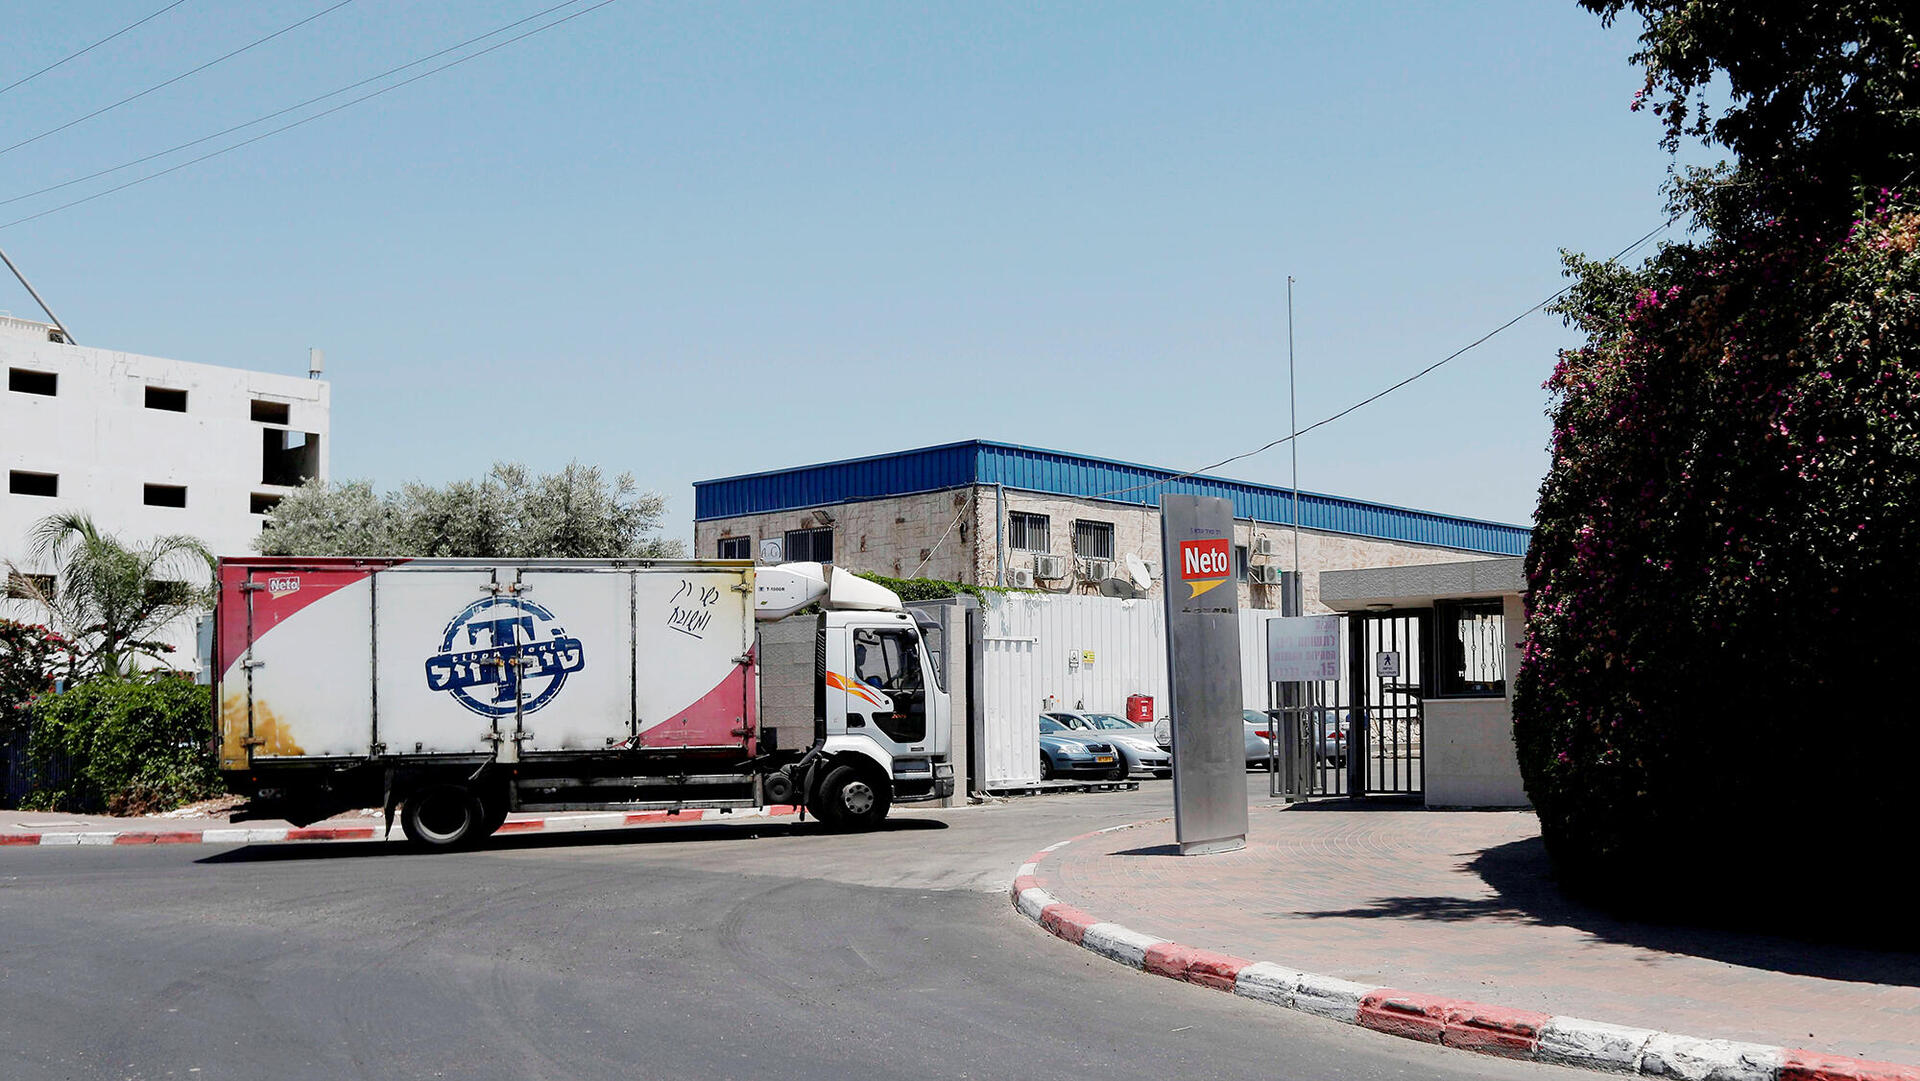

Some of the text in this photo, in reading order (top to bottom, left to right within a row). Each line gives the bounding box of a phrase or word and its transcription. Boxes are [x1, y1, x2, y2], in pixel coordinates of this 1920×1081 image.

[1184, 546, 1228, 574] Neto
[270, 579, 299, 591] Neto
[497, 649, 581, 683] טיבן
[1321, 662, 1336, 676] 15
